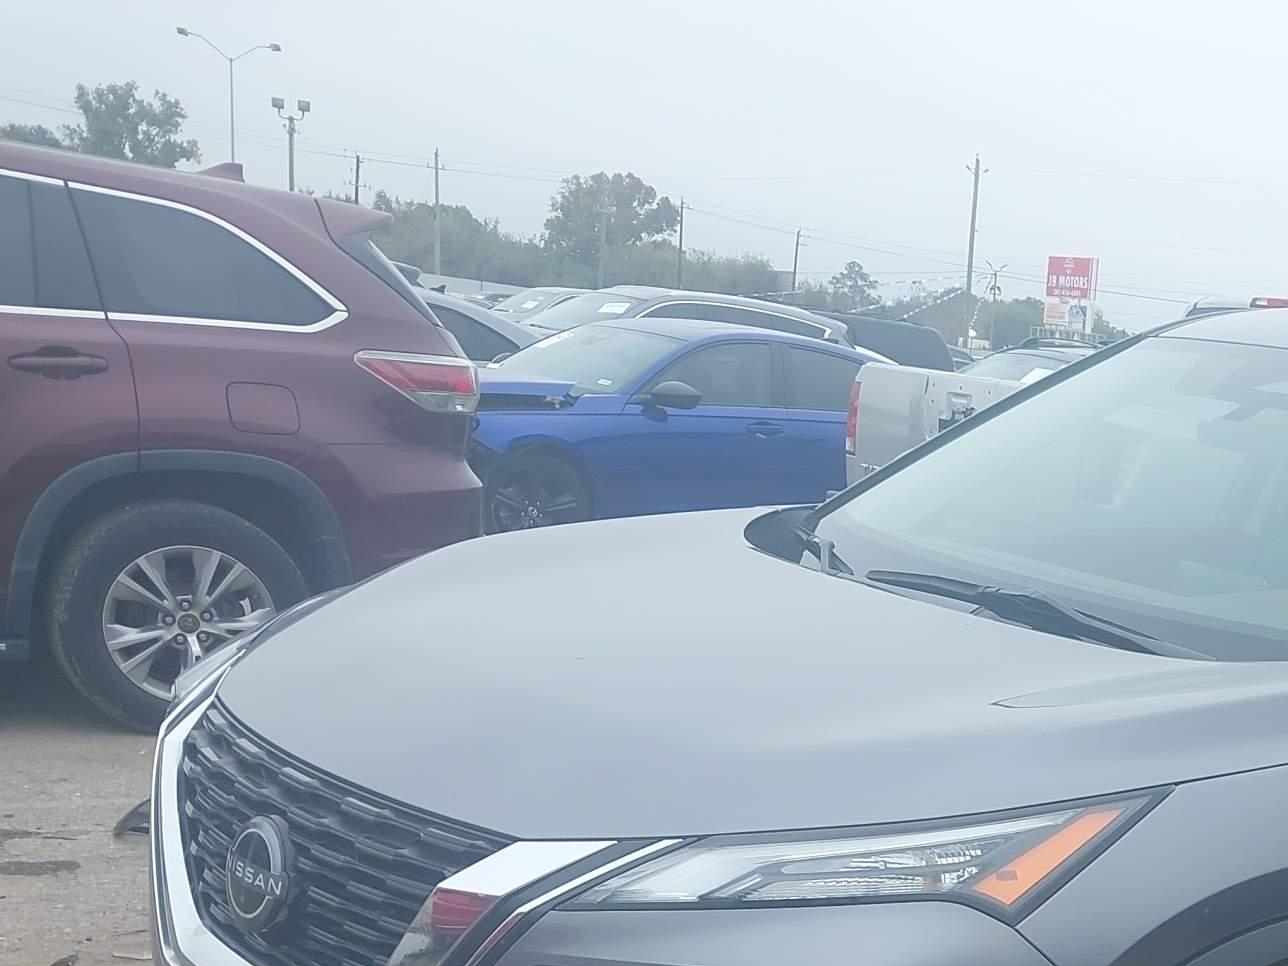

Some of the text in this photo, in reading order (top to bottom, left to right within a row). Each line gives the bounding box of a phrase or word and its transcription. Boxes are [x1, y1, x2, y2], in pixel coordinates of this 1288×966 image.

[1048, 274, 1088, 289] JB MOTORS
[227, 846, 282, 895] NISSAN
